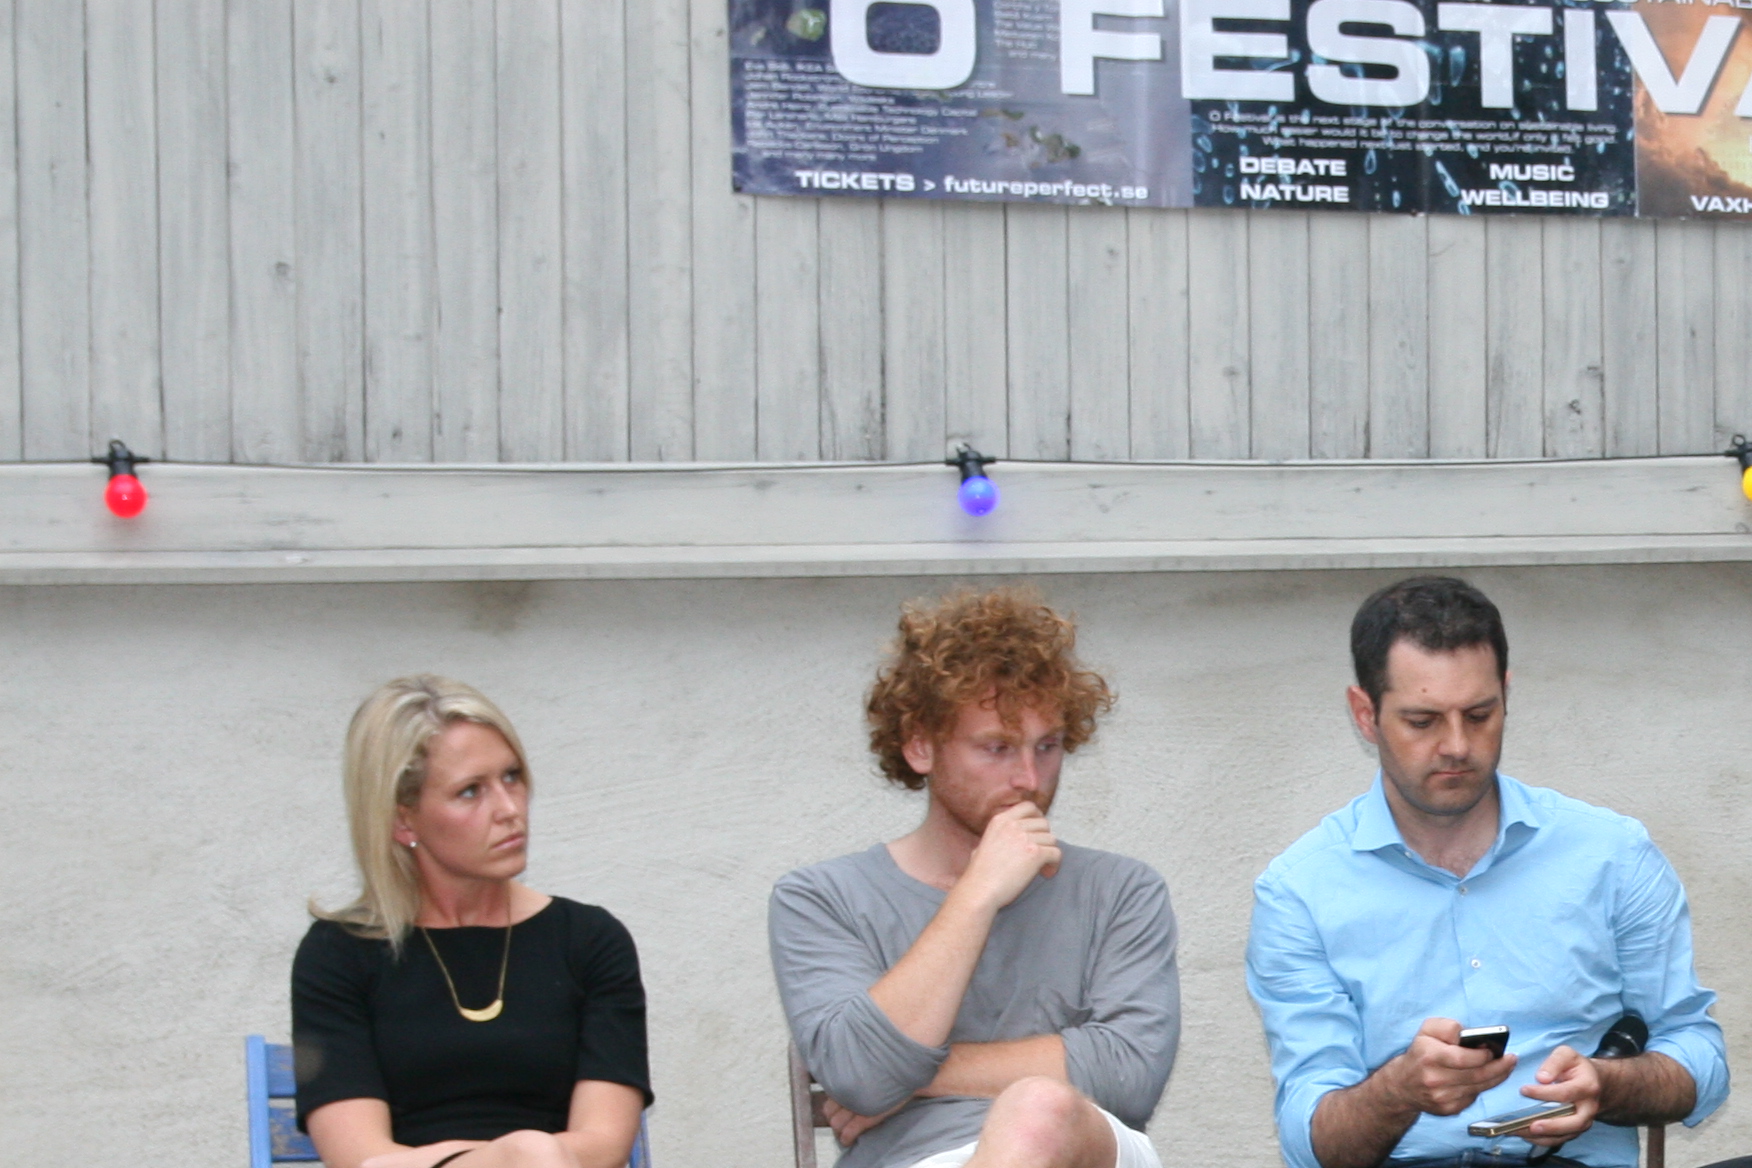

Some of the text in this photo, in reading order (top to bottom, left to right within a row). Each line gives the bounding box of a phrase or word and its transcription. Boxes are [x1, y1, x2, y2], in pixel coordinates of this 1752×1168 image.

[830, 0, 977, 90] O
[1240, 157, 1346, 176] DEBATE
[1489, 163, 1576, 182] MUSIC
[794, 169, 915, 191] TICKETS
[943, 175, 1149, 200] futureperfect.se
[1240, 183, 1350, 203] NATURE
[1460, 189, 1609, 209] WELLBEING
